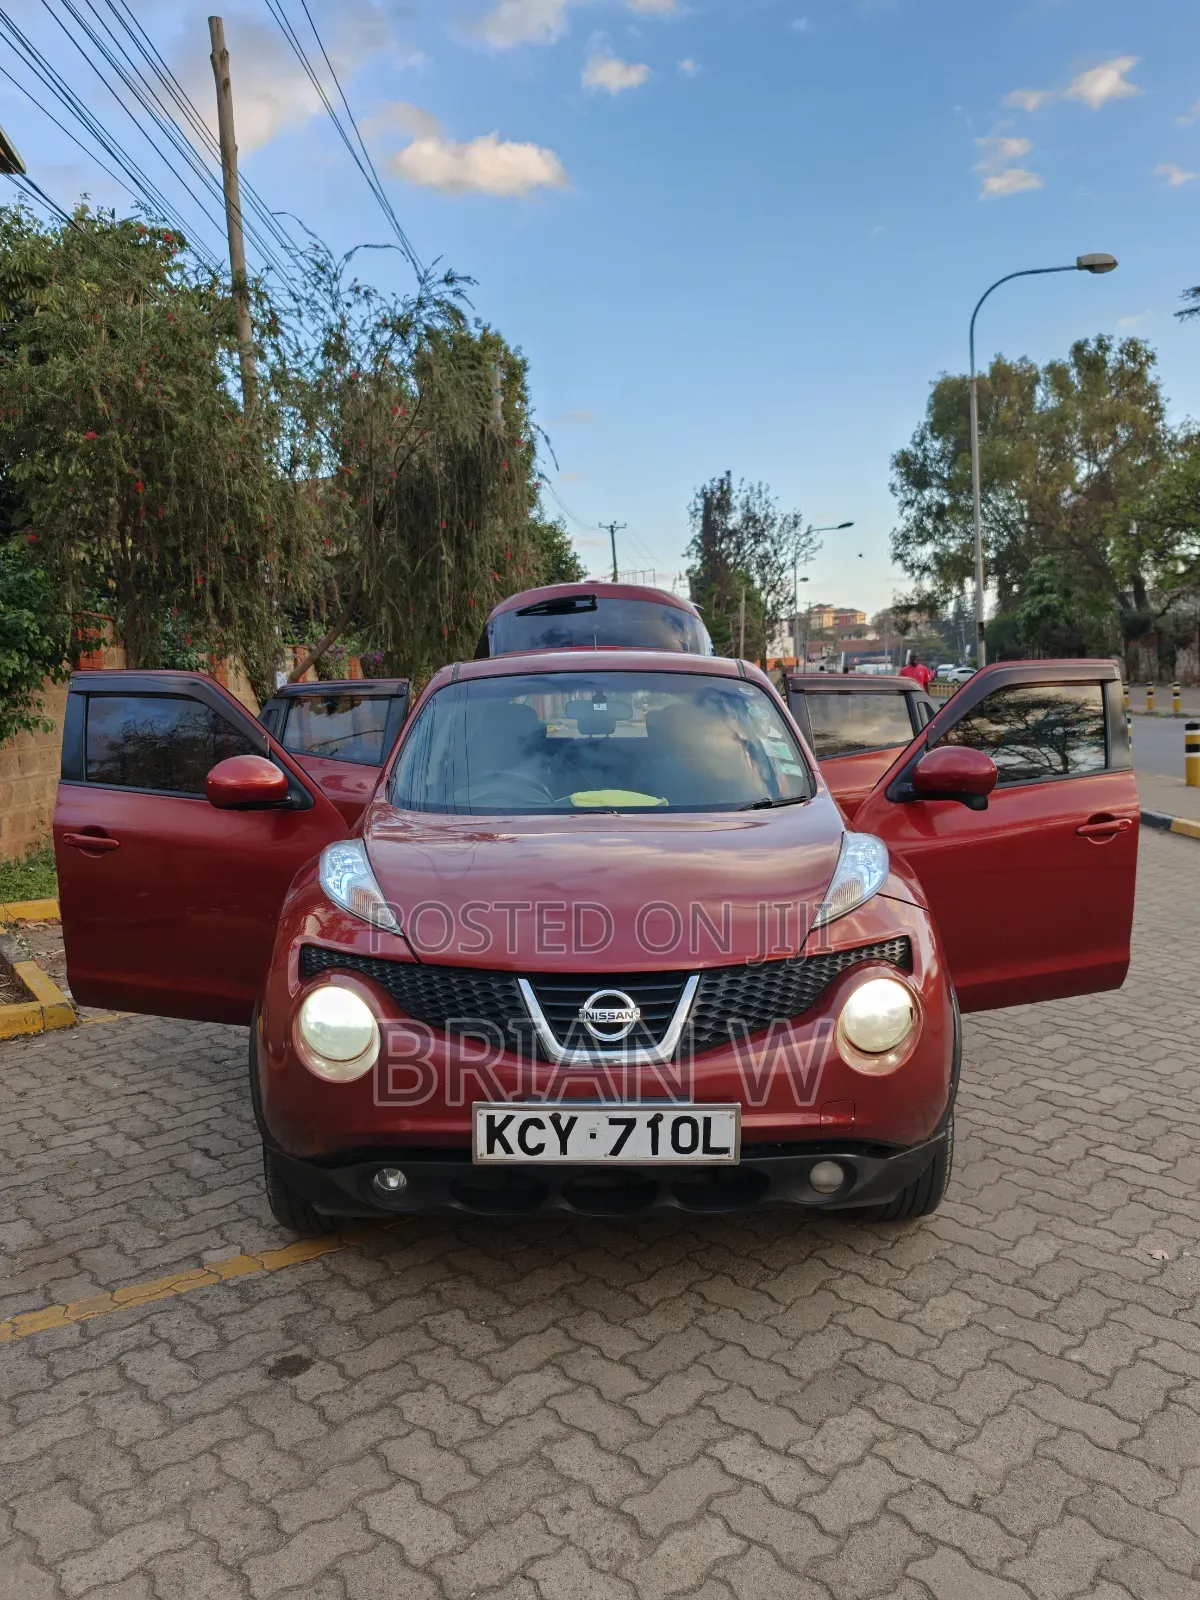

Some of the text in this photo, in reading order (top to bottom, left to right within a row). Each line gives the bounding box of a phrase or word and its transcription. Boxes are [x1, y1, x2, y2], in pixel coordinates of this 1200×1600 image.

[585, 1010, 634, 1021] NISSAN
[486, 1114, 731, 1156] KCY 710L
